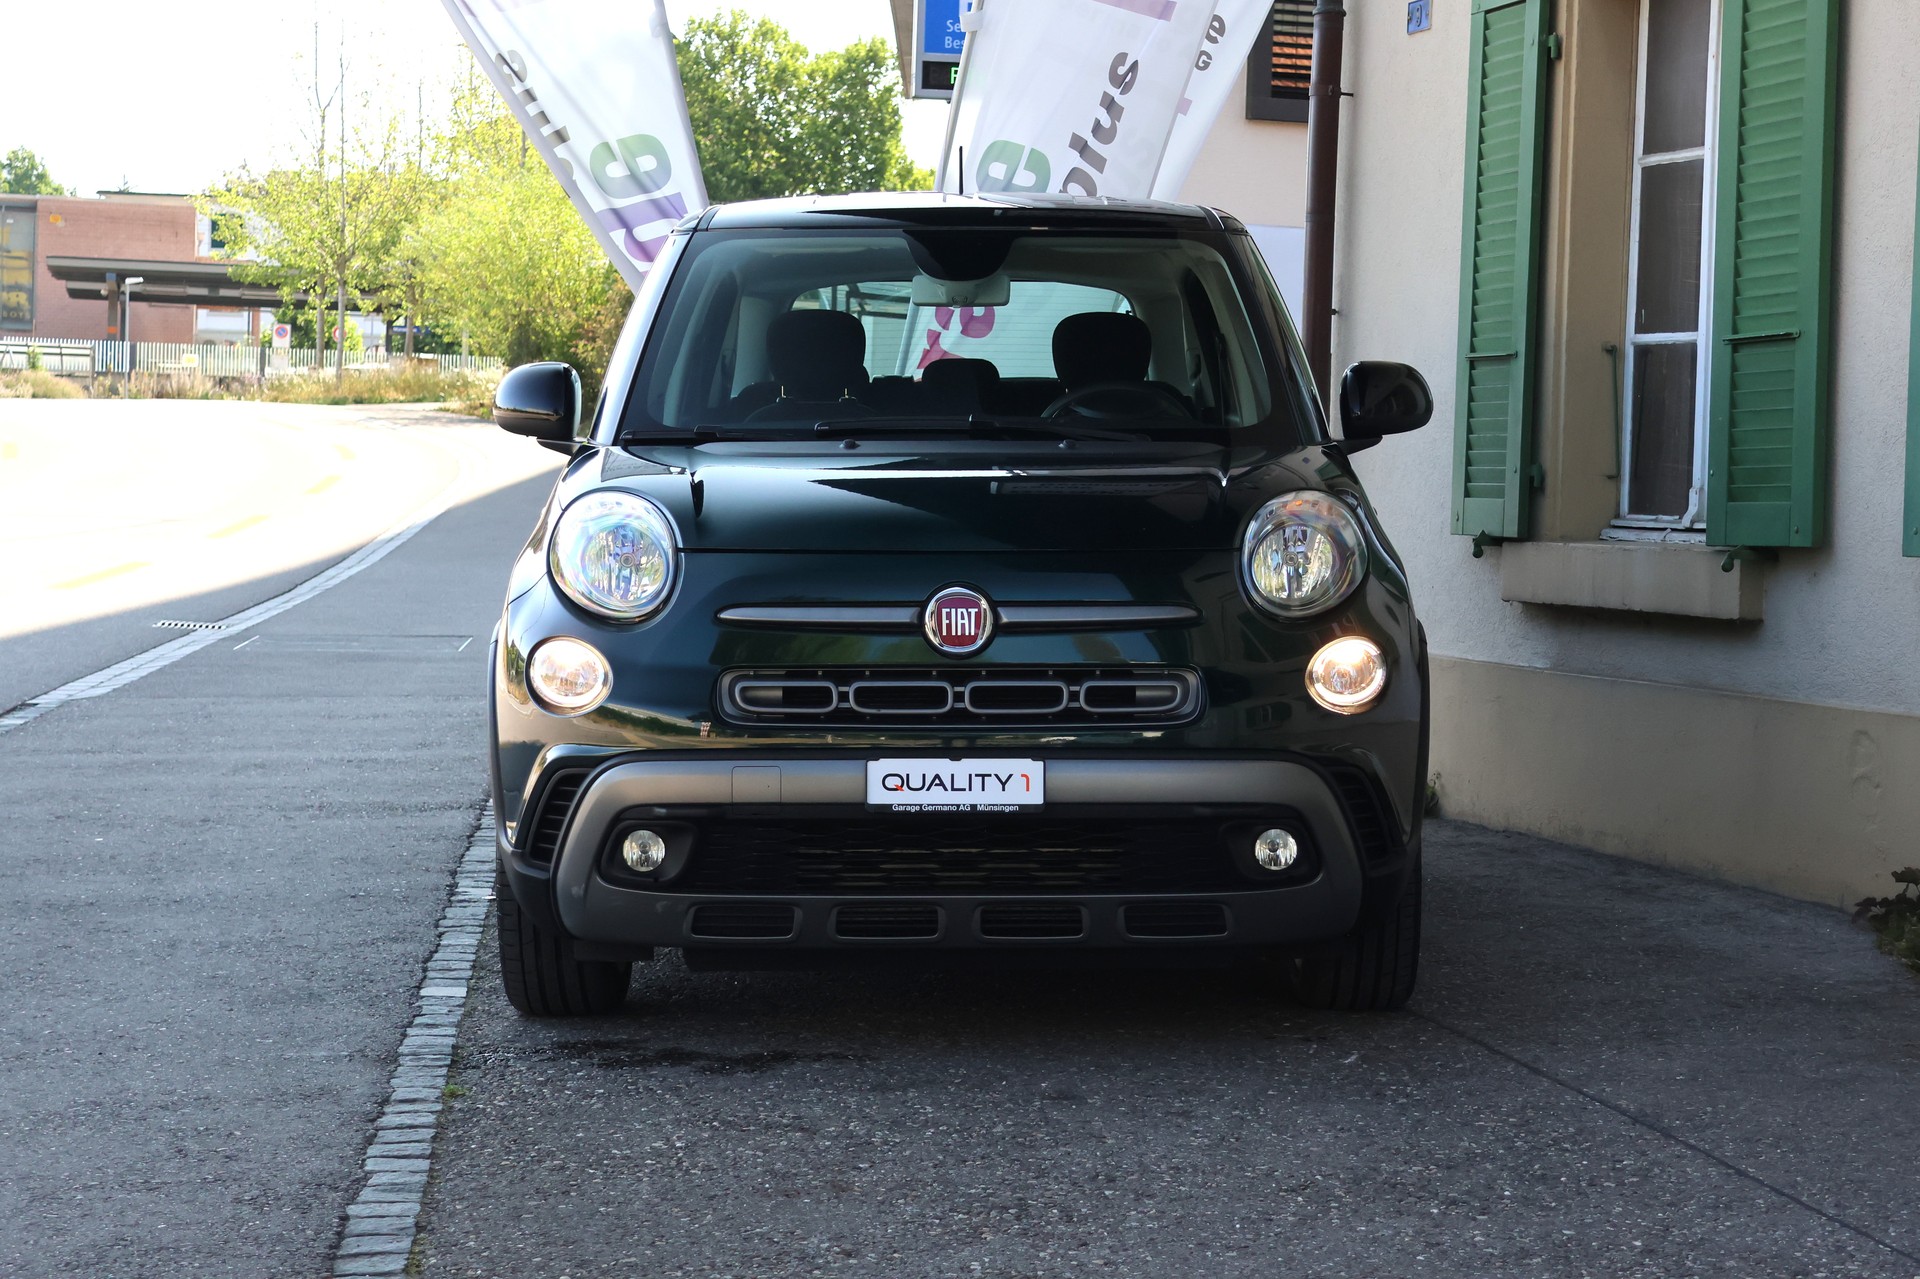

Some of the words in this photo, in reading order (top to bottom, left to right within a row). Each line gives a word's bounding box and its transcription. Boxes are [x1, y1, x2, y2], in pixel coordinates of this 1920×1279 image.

[941, 607, 979, 636] FIAT
[881, 772, 1014, 793] QUALITY
[1020, 773, 1031, 792] 1
[892, 803, 920, 813] Garage
[922, 803, 957, 812] Germano
[959, 803, 971, 812] AG
[976, 803, 1019, 813] Münsingen
